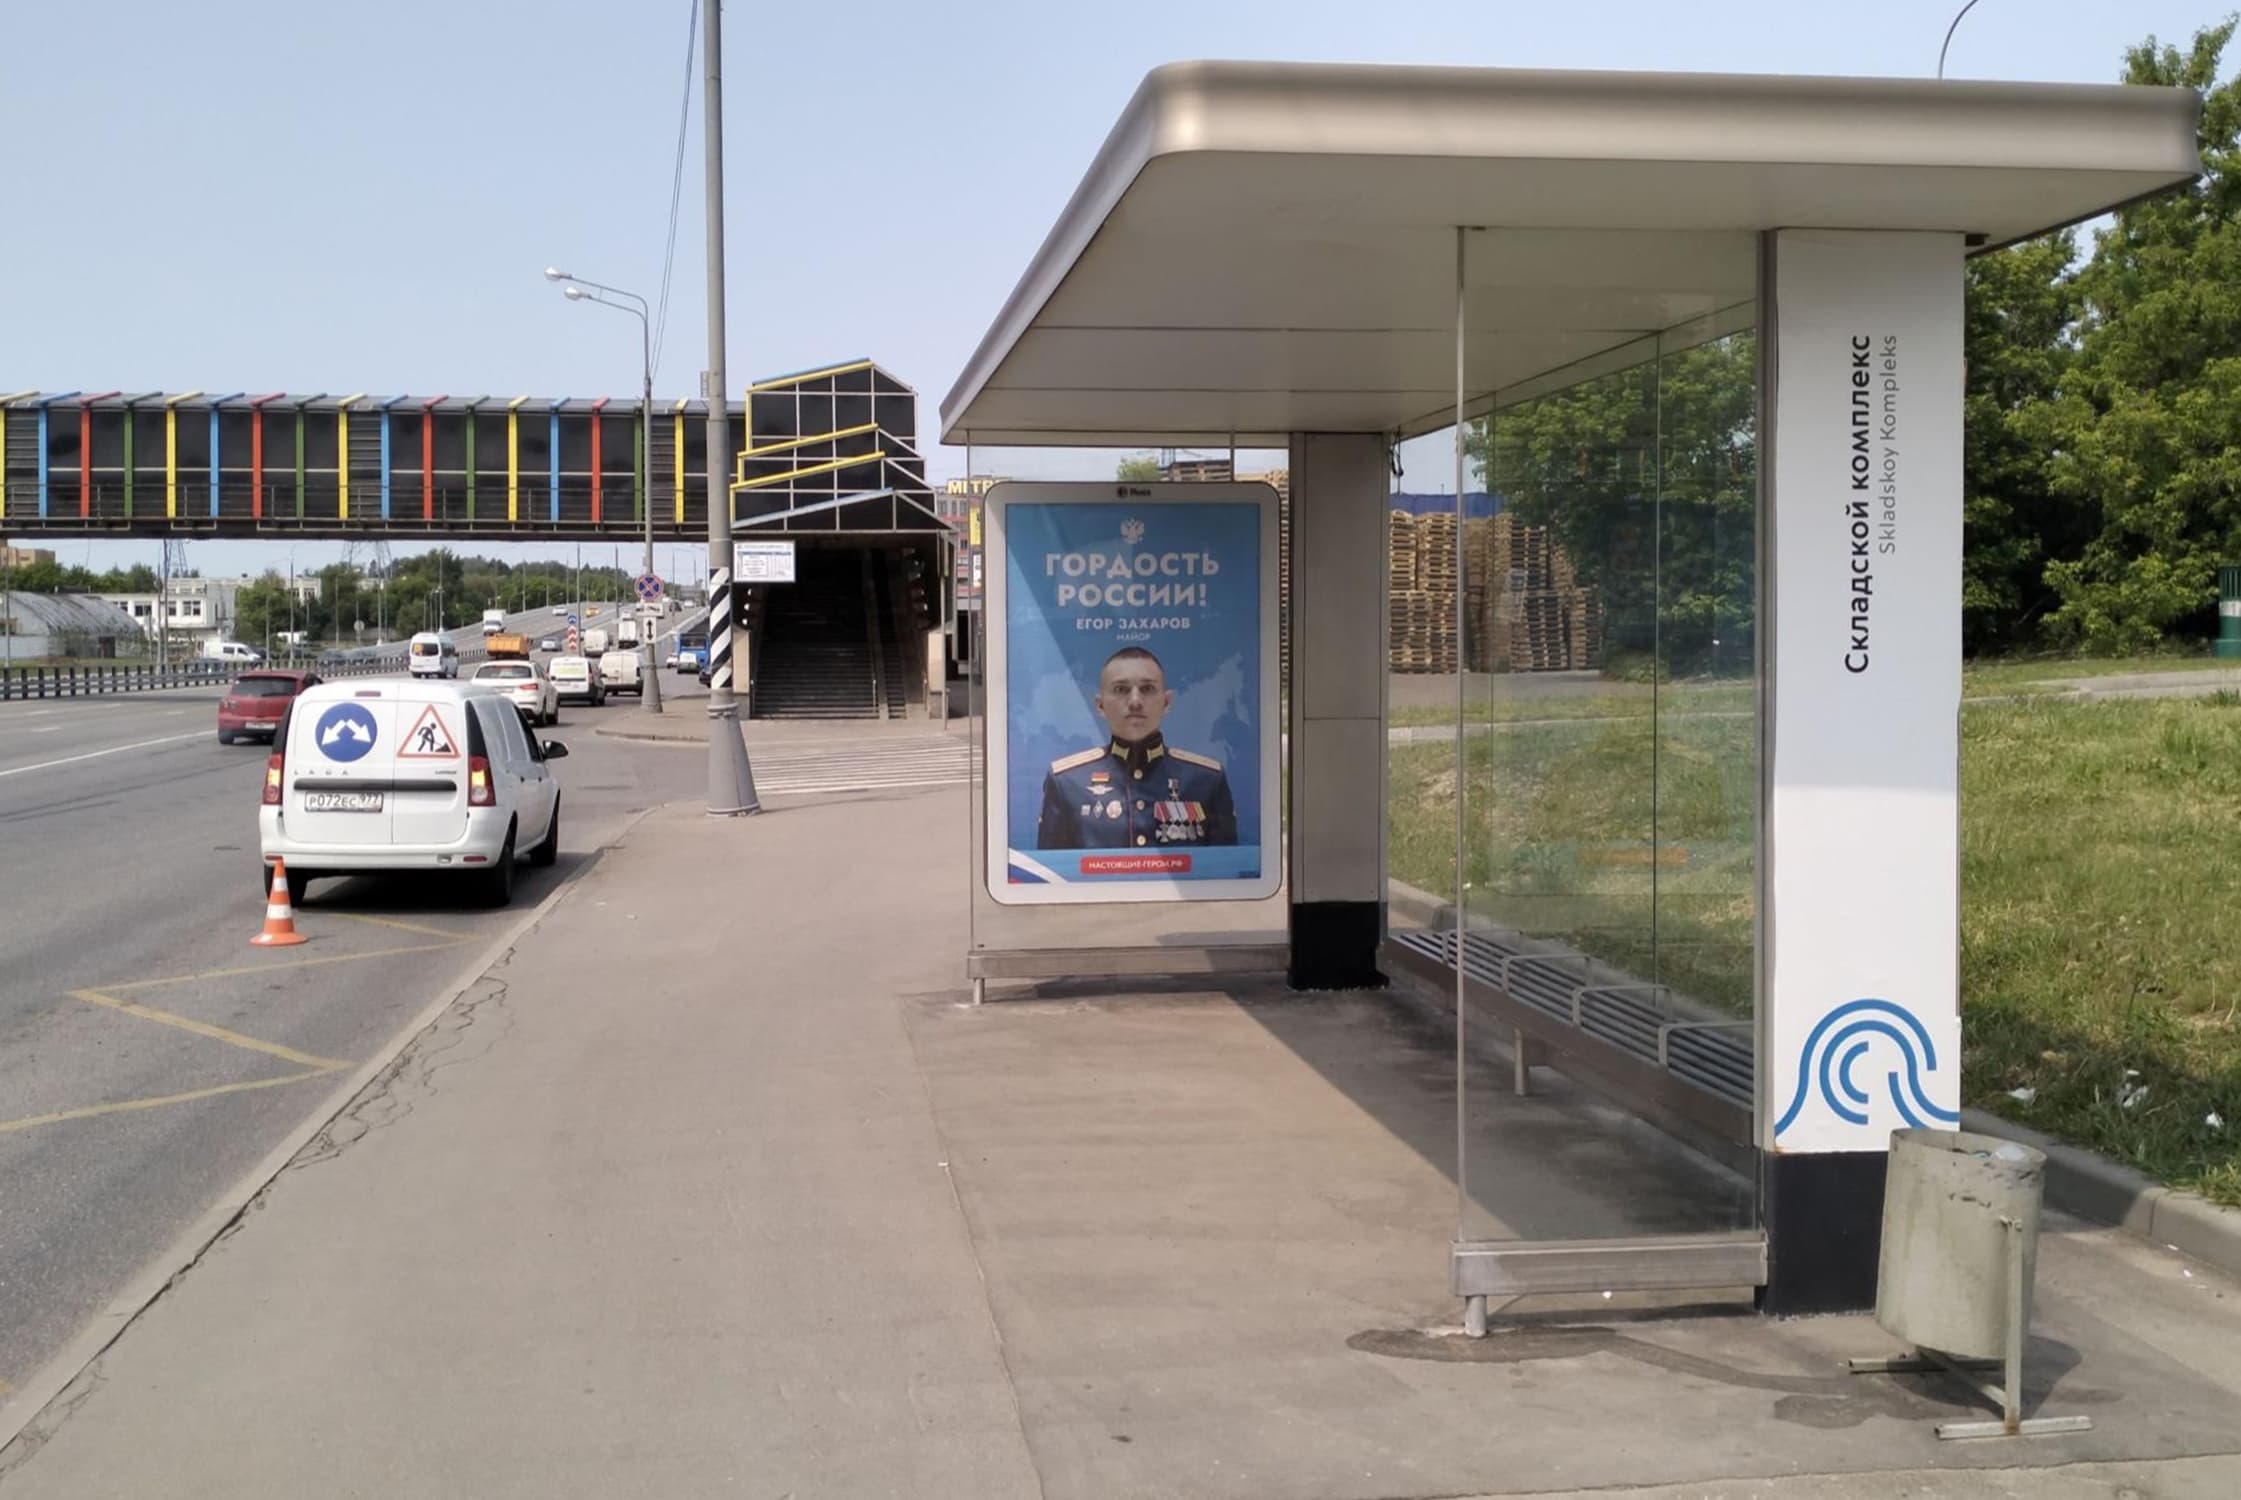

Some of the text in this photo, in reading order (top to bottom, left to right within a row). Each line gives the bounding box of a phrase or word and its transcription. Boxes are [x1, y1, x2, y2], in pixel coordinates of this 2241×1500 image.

[1878, 334, 1900, 555] Skladskoy Kompleks
[1844, 334, 1873, 674] Складской комплекс
[1046, 552, 1220, 579] ГОРДОСТЬ
[1057, 583, 1208, 608] РОССИИ!
[1076, 616, 1191, 630] ЕГОР ЗАХАРОВ
[1115, 631, 1152, 642] МАЙОР
